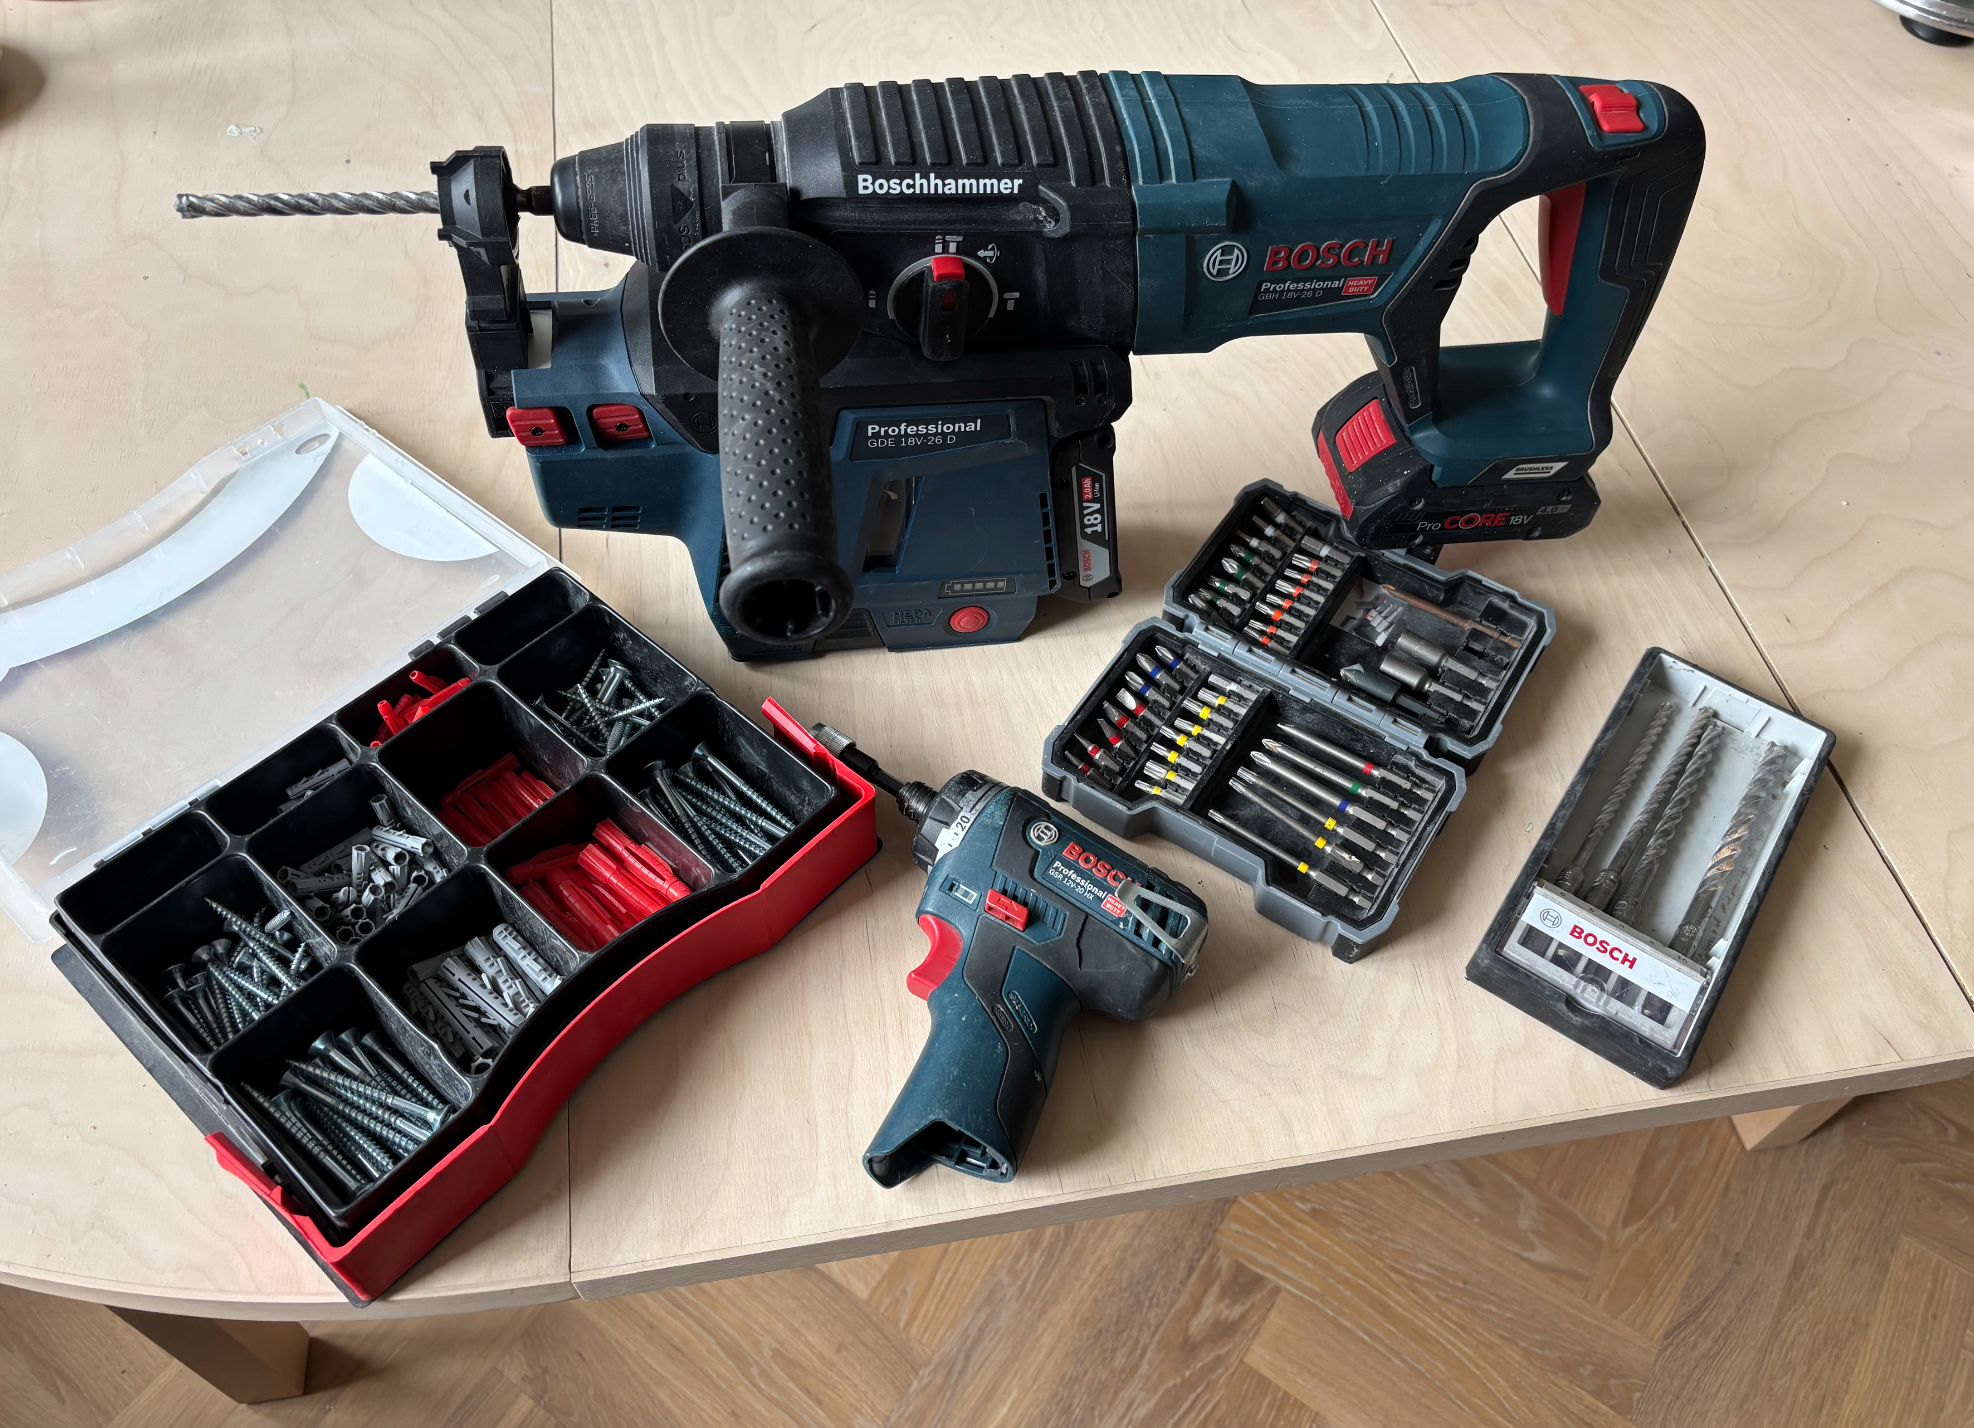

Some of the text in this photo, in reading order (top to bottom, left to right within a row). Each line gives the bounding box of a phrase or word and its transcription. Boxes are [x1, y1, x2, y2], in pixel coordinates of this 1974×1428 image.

[674, 150, 687, 182] plus
[857, 173, 1023, 194] Boschhammer
[1264, 238, 1395, 272] BOSCH
[1261, 278, 1344, 292] Professional
[1258, 293, 1279, 301] GBH
[1281, 290, 1313, 299] 18V-26
[867, 418, 981, 437] Professional
[868, 435, 956, 448] GDE 18V-26 D
[1084, 478, 1092, 500] 2.0 Ah
[1083, 503, 1102, 534] 18V
[1539, 506, 1558, 514] 4.0
[1416, 513, 1533, 532] Pro CORE 18V
[1083, 550, 1092, 572] BOSCH
[892, 608, 931, 620] HEPA
[956, 815, 971, 832] 20
[1062, 841, 1142, 888] BOSC
[1049, 868, 1064, 881] GSR
[1063, 877, 1084, 894] 12V-20
[1053, 861, 1108, 899] Professional
[1105, 902, 1121, 915] DUTY
[1107, 895, 1126, 910] HEAVY
[1568, 924, 1638, 970] BOSCH
